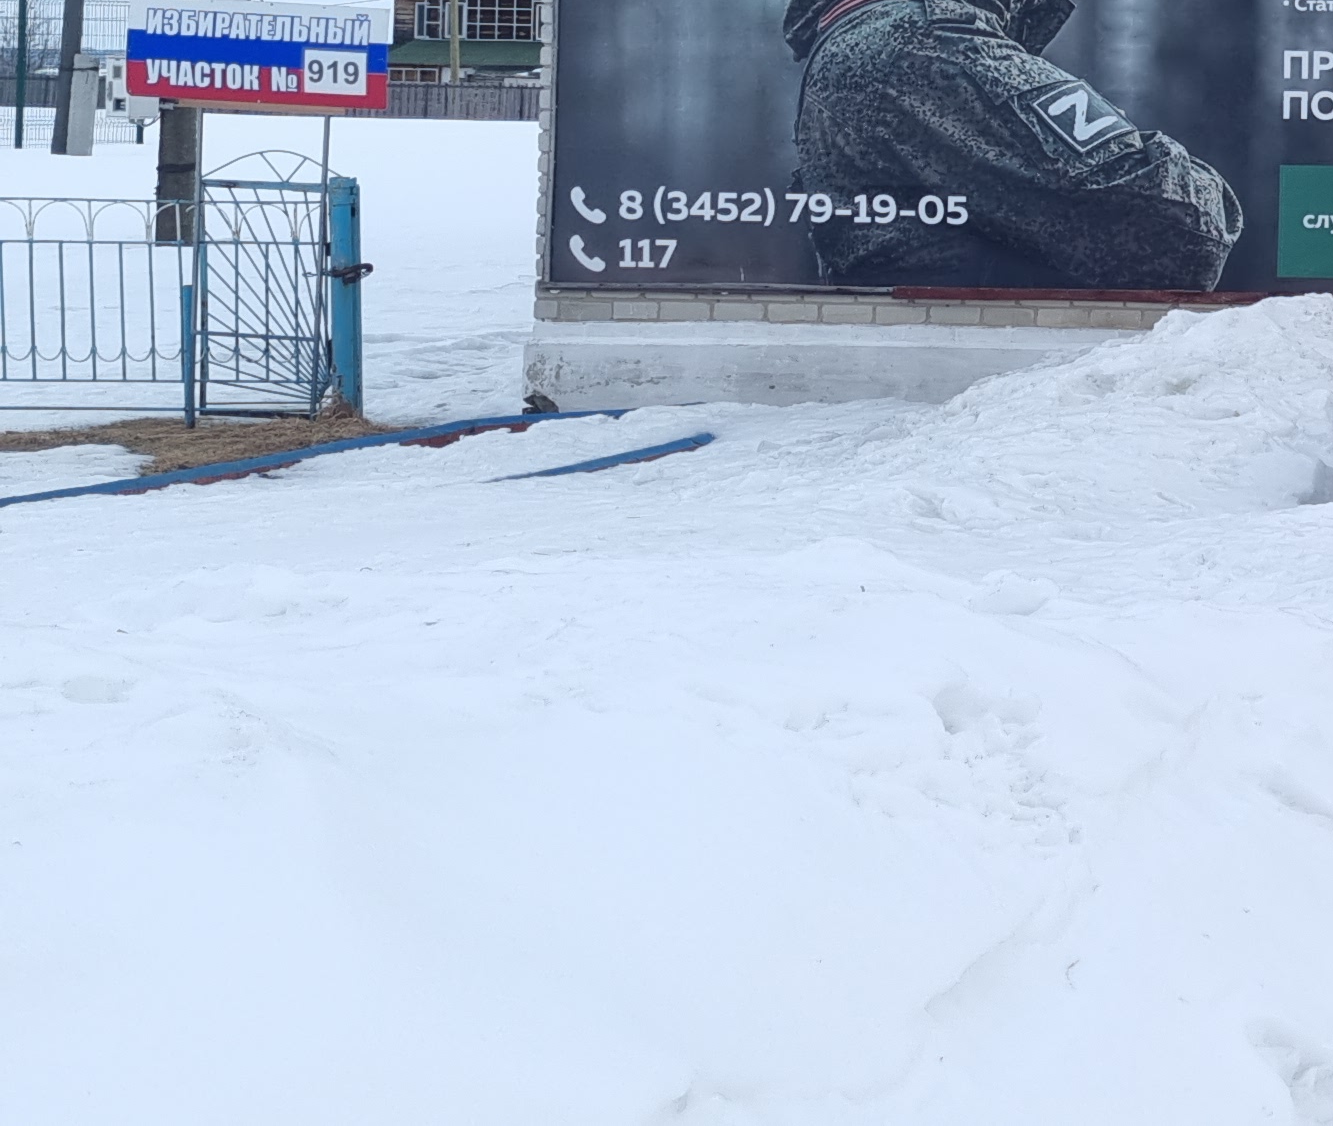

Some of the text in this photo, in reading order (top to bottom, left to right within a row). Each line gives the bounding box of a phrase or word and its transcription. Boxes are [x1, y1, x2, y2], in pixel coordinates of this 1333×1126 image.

[146, 8, 370, 46] ИЗБИРАТЕЛЬНЫЙ
[146, 59, 360, 92] УЧАСТОК № 919
[1048, 91, 1117, 142] Z
[618, 187, 969, 226] 8 (3452) 79-19-05
[618, 240, 677, 268] 117
